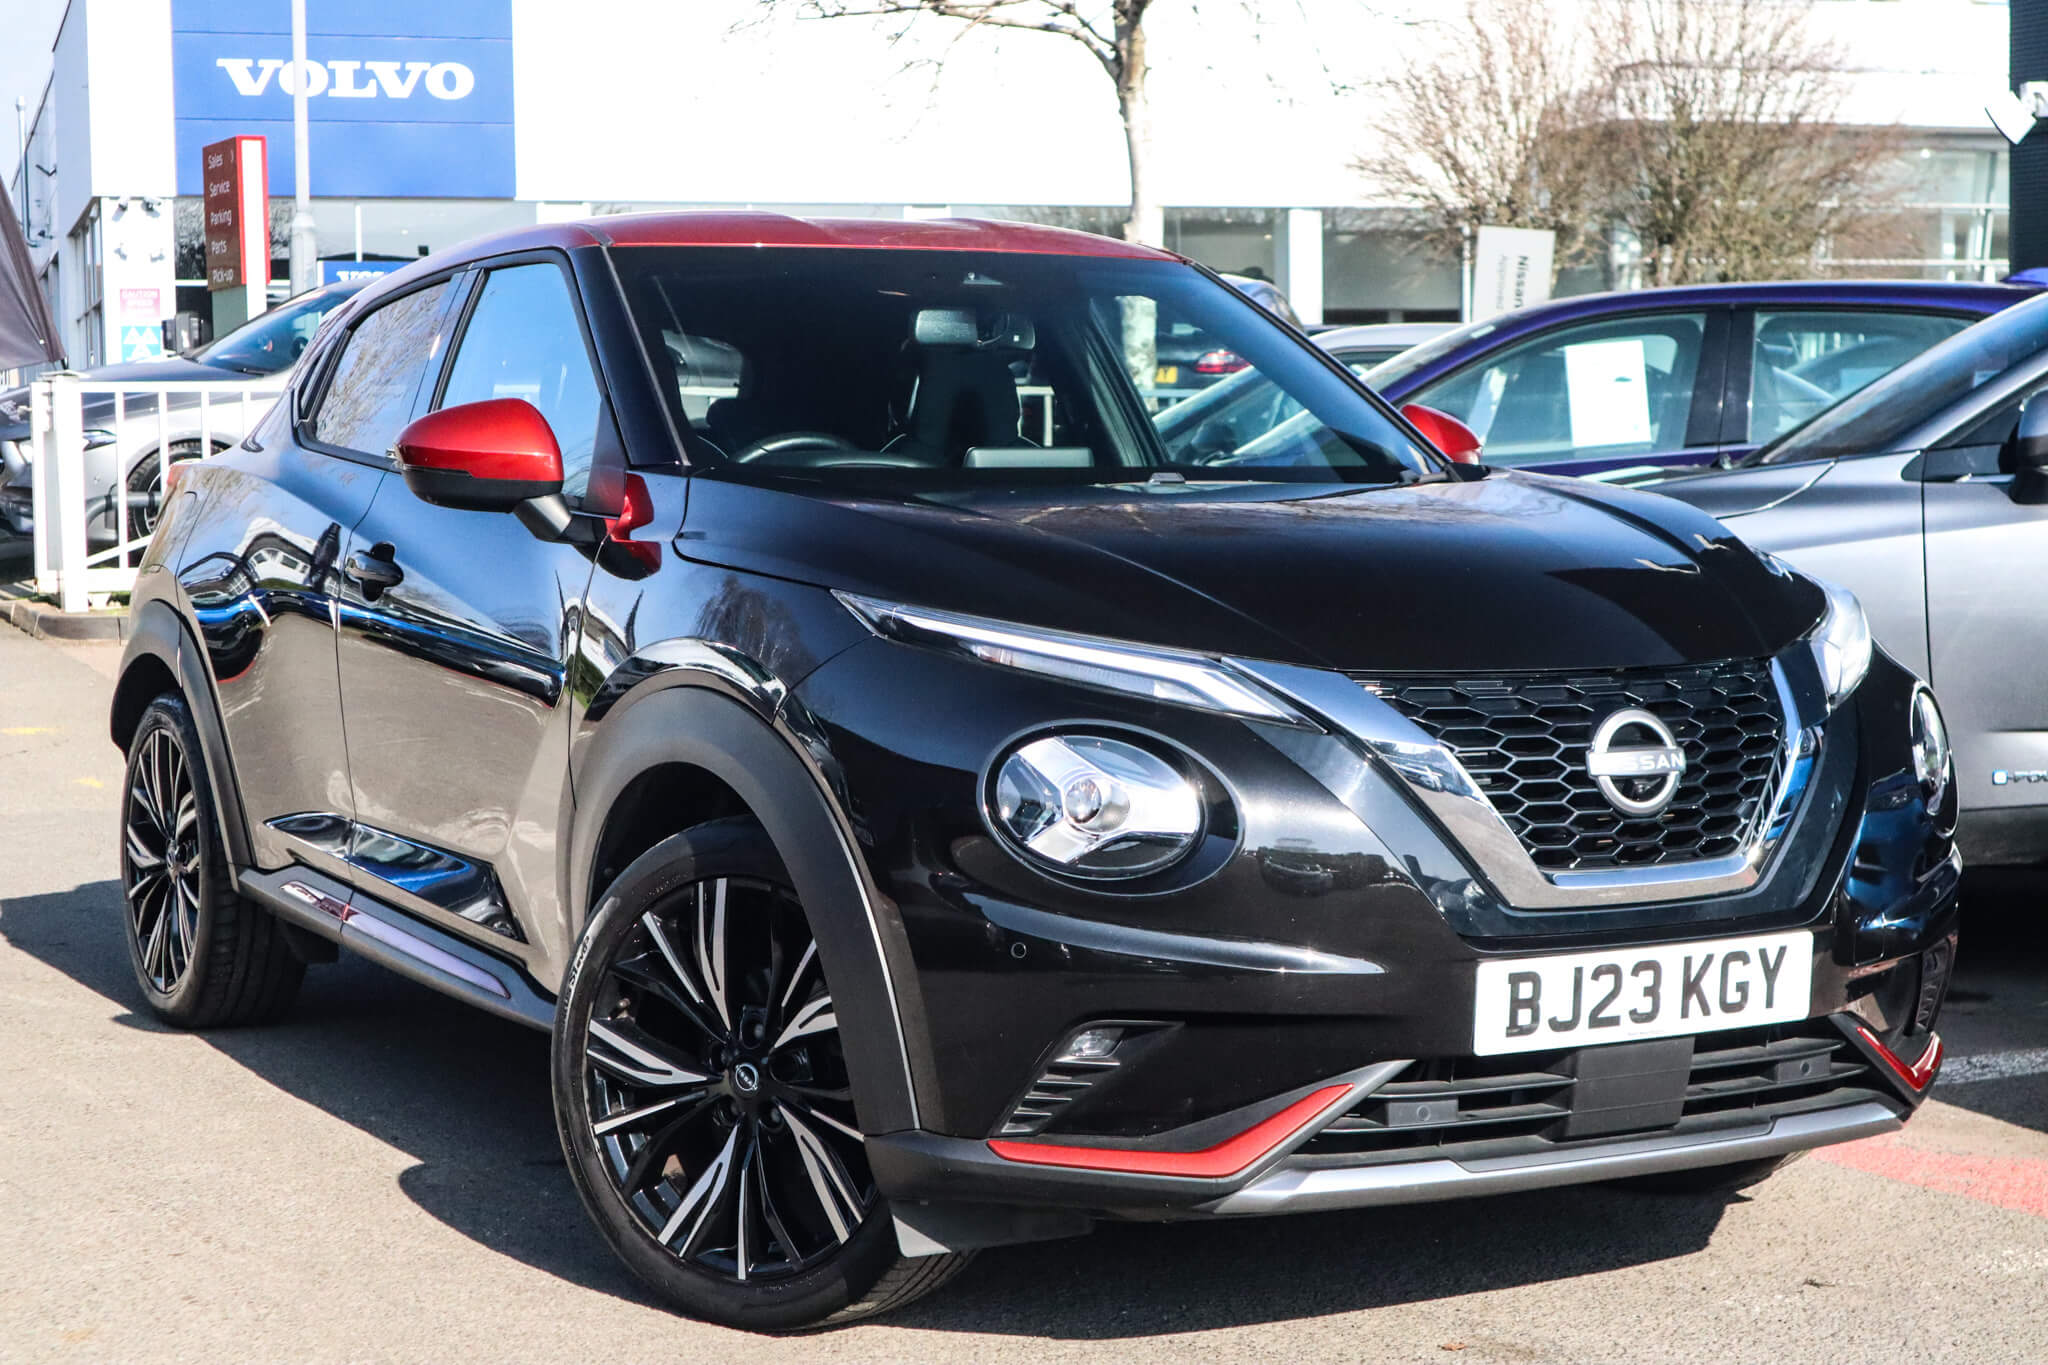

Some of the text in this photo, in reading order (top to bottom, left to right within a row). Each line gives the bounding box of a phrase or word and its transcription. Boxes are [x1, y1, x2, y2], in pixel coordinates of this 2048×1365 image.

[216, 58, 475, 100] VOLVO
[208, 153, 223, 169] Sales
[209, 180, 230, 197] Service
[210, 209, 232, 226] Parking
[211, 240, 227, 255] Parts
[212, 268, 234, 285] Pick-up
[1514, 254, 1529, 309] Nissan
[1505, 945, 1788, 1038] BJ23 KGY
